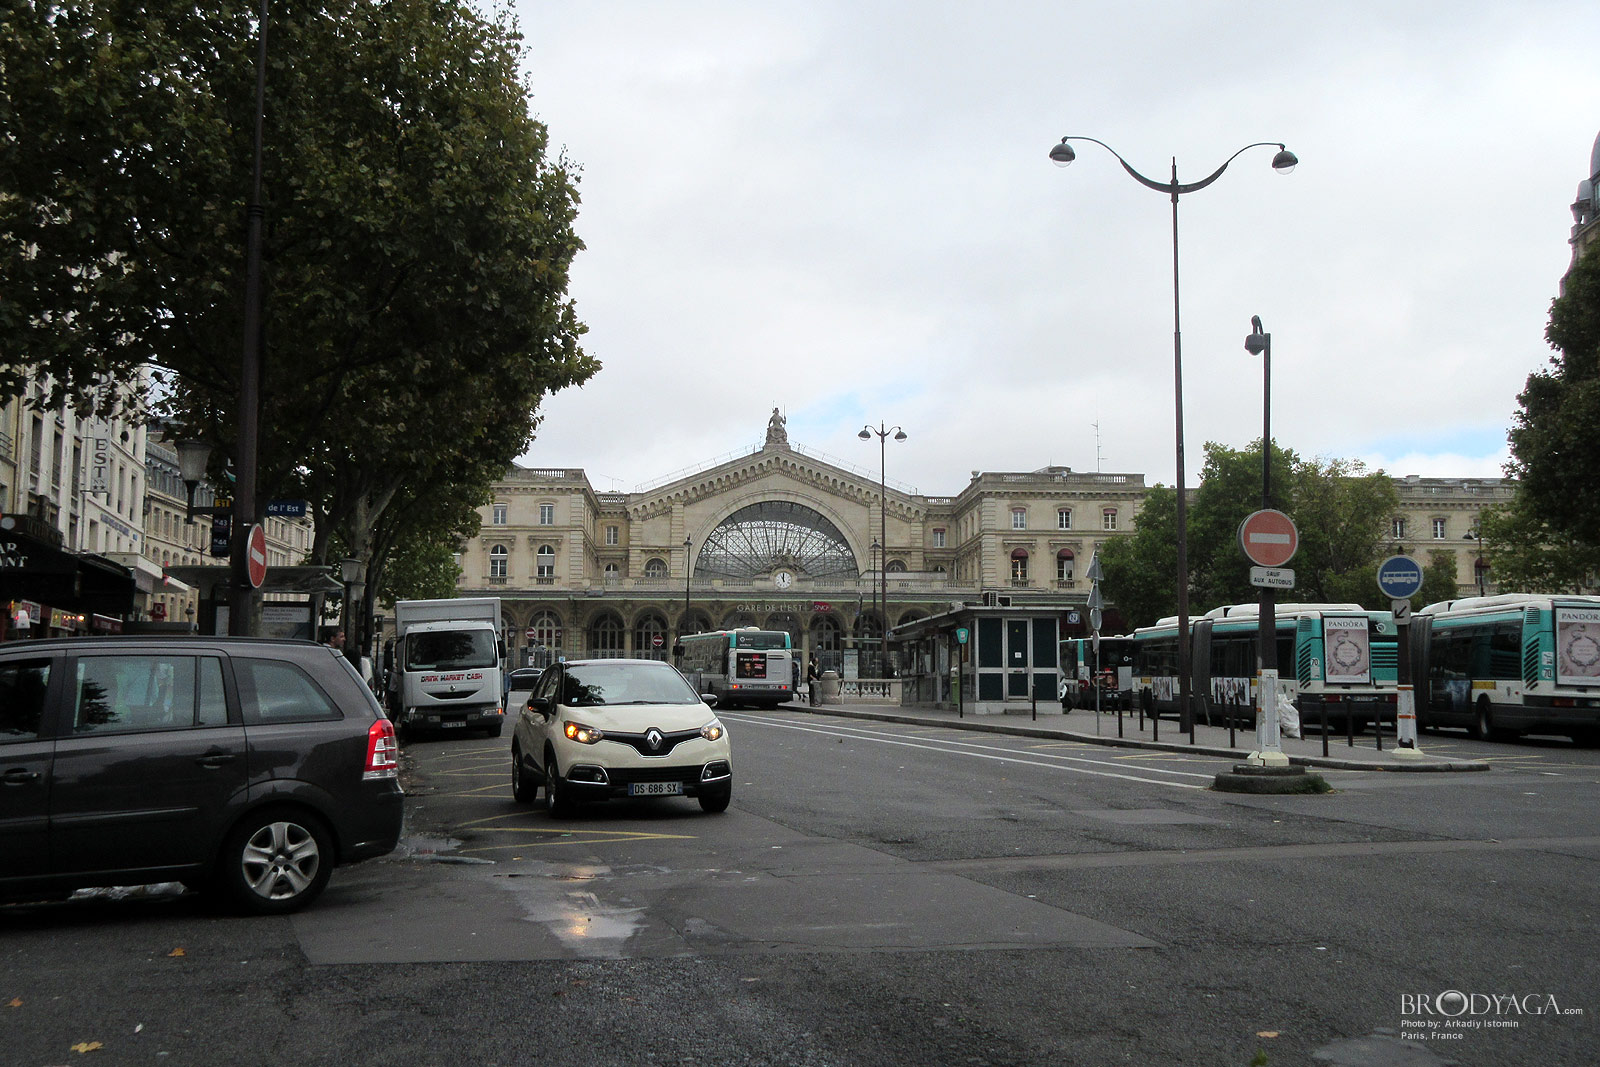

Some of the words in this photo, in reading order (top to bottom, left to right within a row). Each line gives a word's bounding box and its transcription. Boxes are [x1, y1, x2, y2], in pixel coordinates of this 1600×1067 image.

[287, 504, 299, 512] Est
[736, 604, 760, 612] GARE
[780, 603, 803, 611] L'EST
[1561, 611, 1600, 621] PANDOR
[1311, 658, 1319, 666] 70
